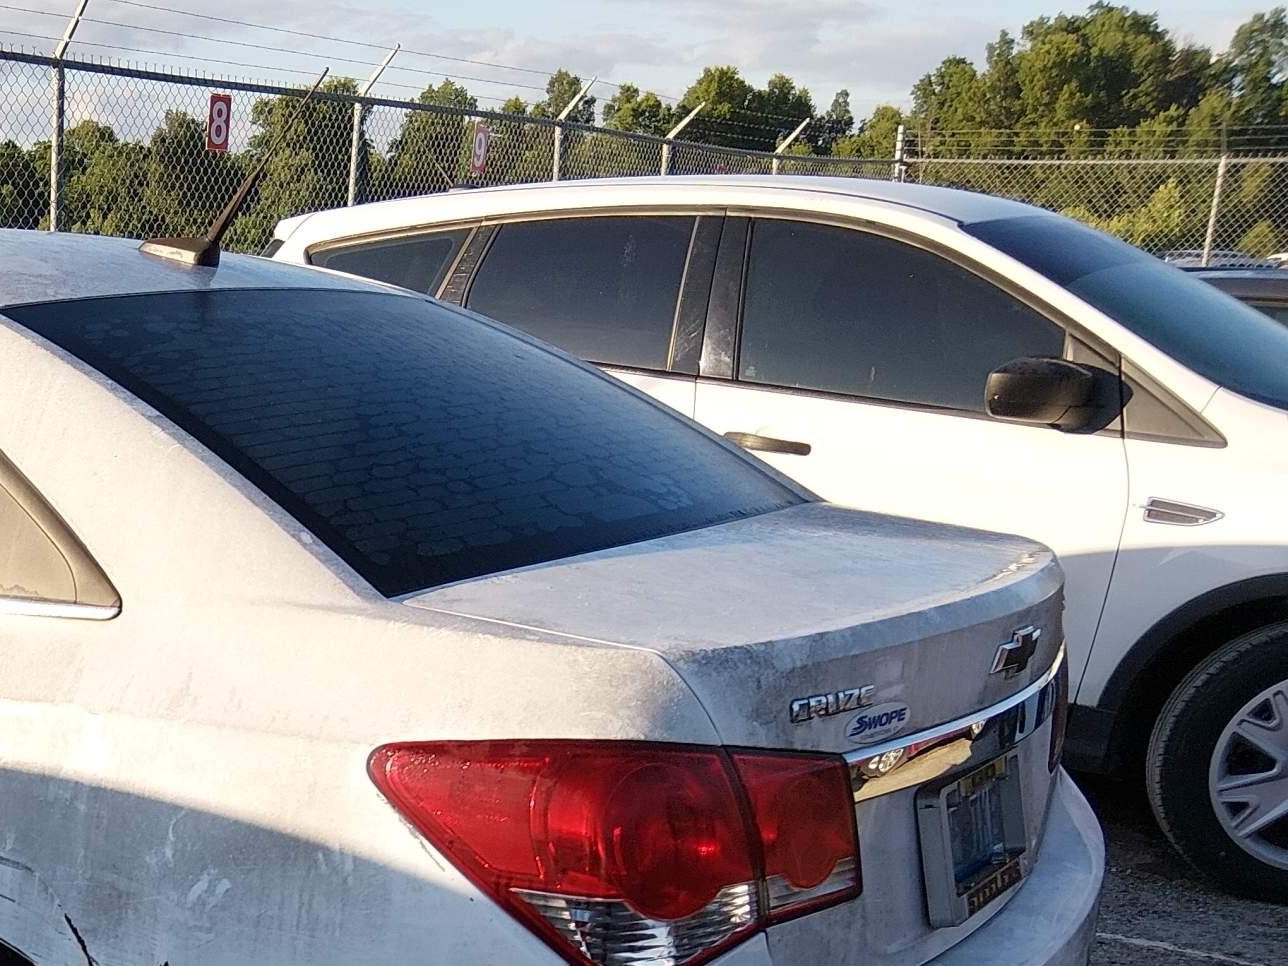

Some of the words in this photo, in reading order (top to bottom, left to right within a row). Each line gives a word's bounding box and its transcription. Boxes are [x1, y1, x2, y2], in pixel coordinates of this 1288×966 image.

[210, 101, 228, 145] 8
[474, 132, 486, 168] 9
[790, 684, 876, 723] CRUZE
